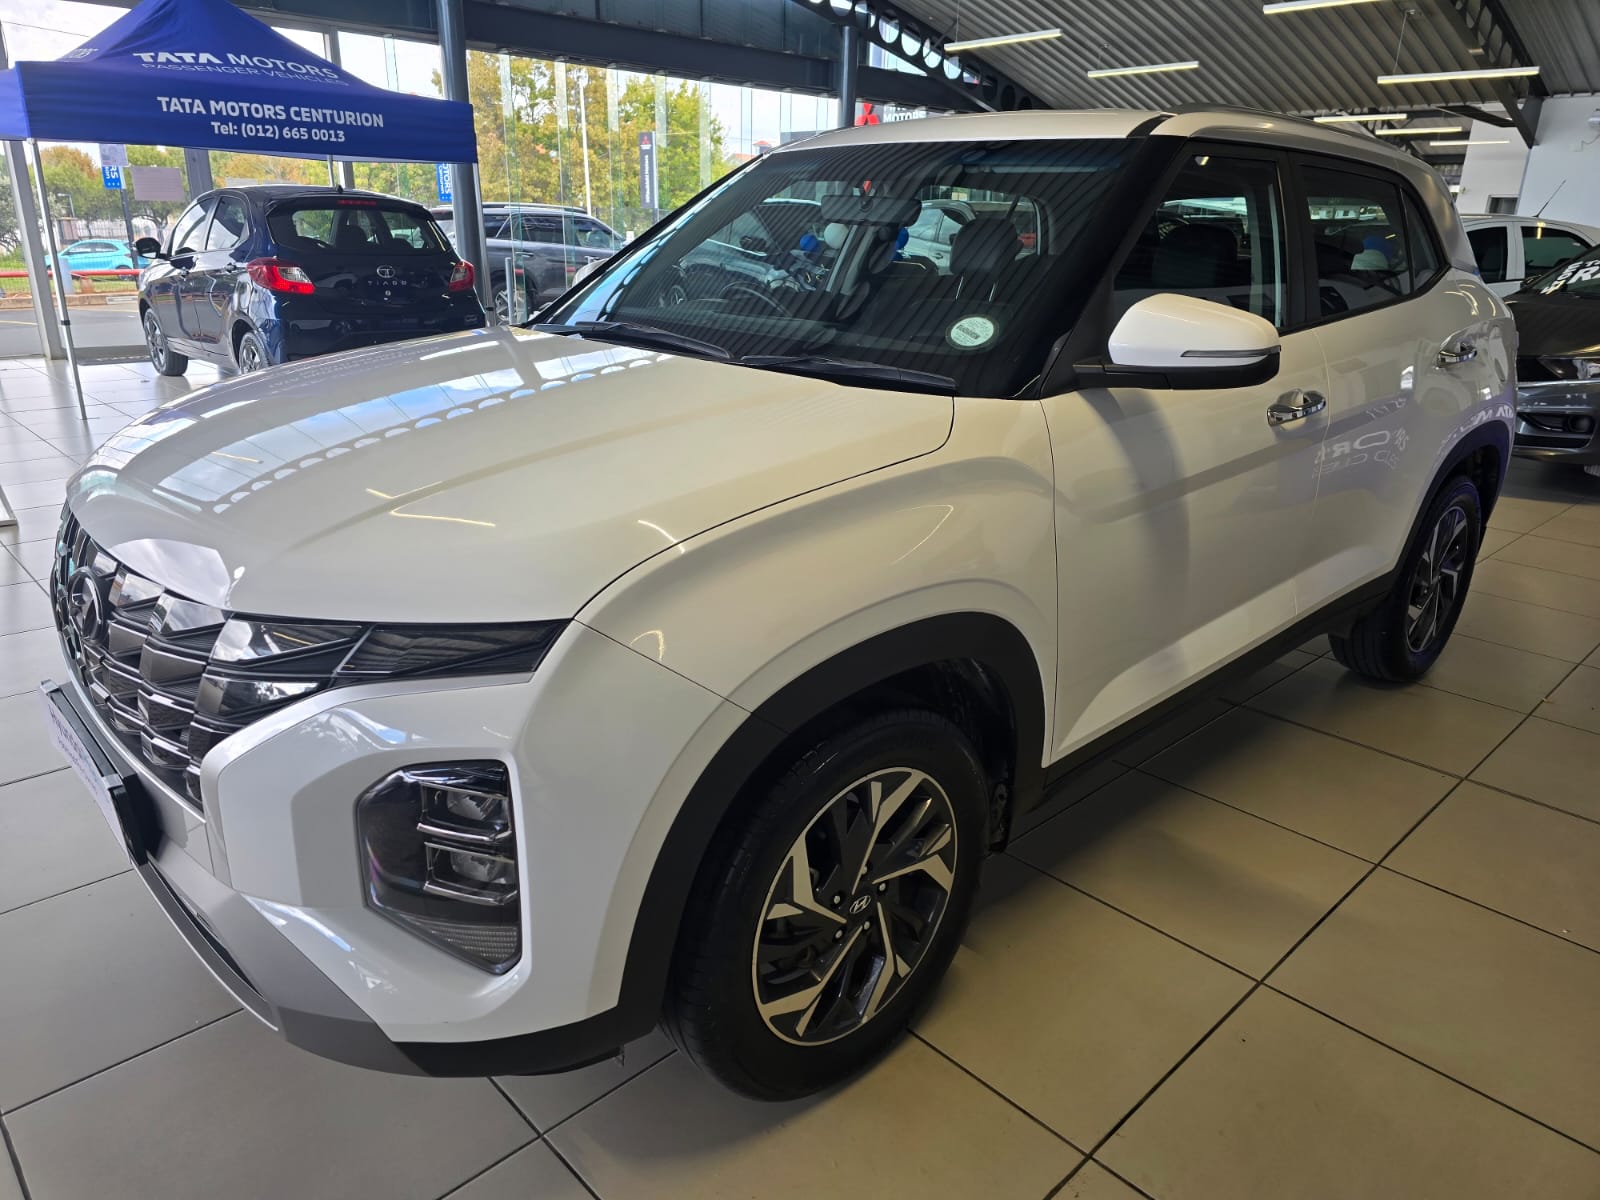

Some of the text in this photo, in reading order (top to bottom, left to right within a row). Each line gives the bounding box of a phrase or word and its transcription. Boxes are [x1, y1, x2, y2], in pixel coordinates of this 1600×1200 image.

[133, 52, 340, 80] TATA MOTORS
[142, 63, 350, 86] PASSENGER VEHICLES
[157, 96, 384, 128] TATA MOTORS CENTURION
[211, 121, 346, 142] Tel: (012) 665 0013
